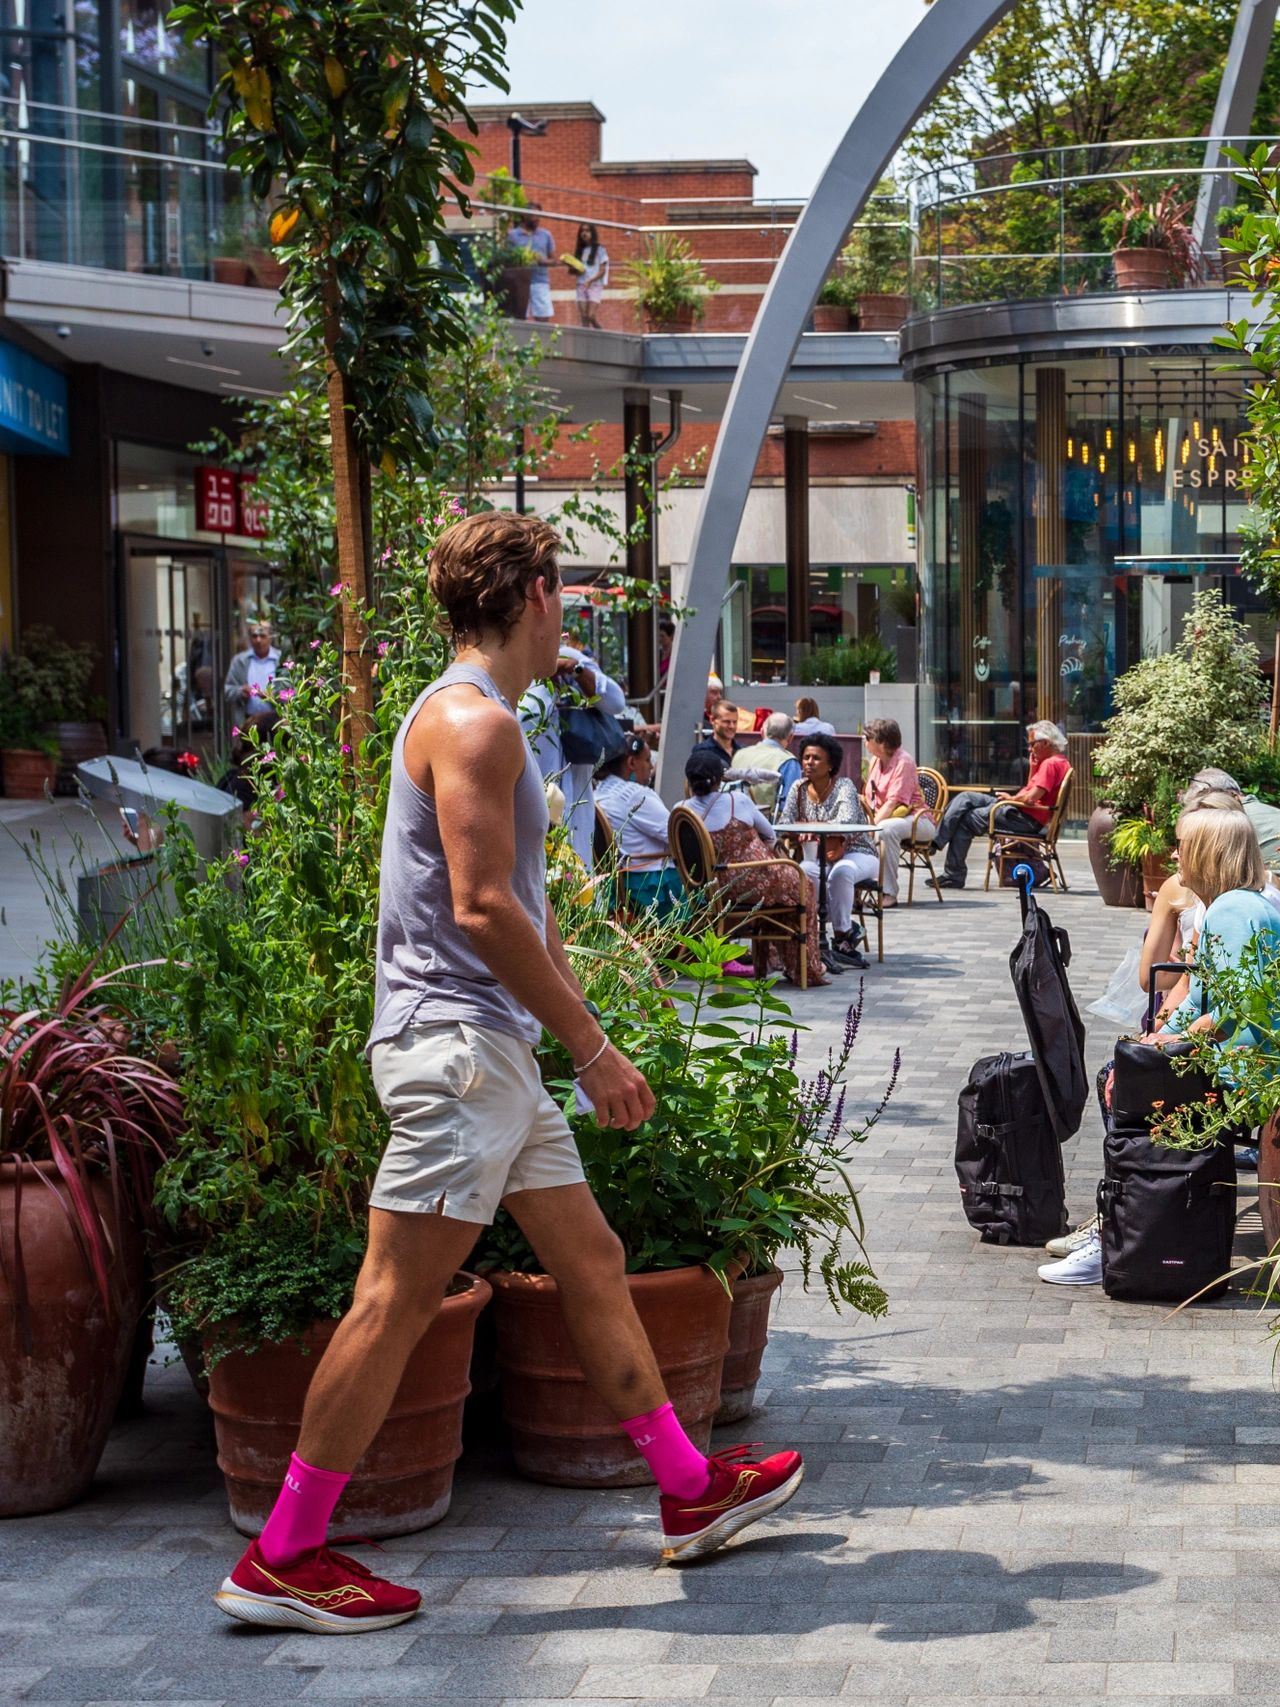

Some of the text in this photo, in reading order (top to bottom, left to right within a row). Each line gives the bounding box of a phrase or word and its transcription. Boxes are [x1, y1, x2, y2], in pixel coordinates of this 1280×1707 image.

[0, 375, 64, 440] NIT TO LET
